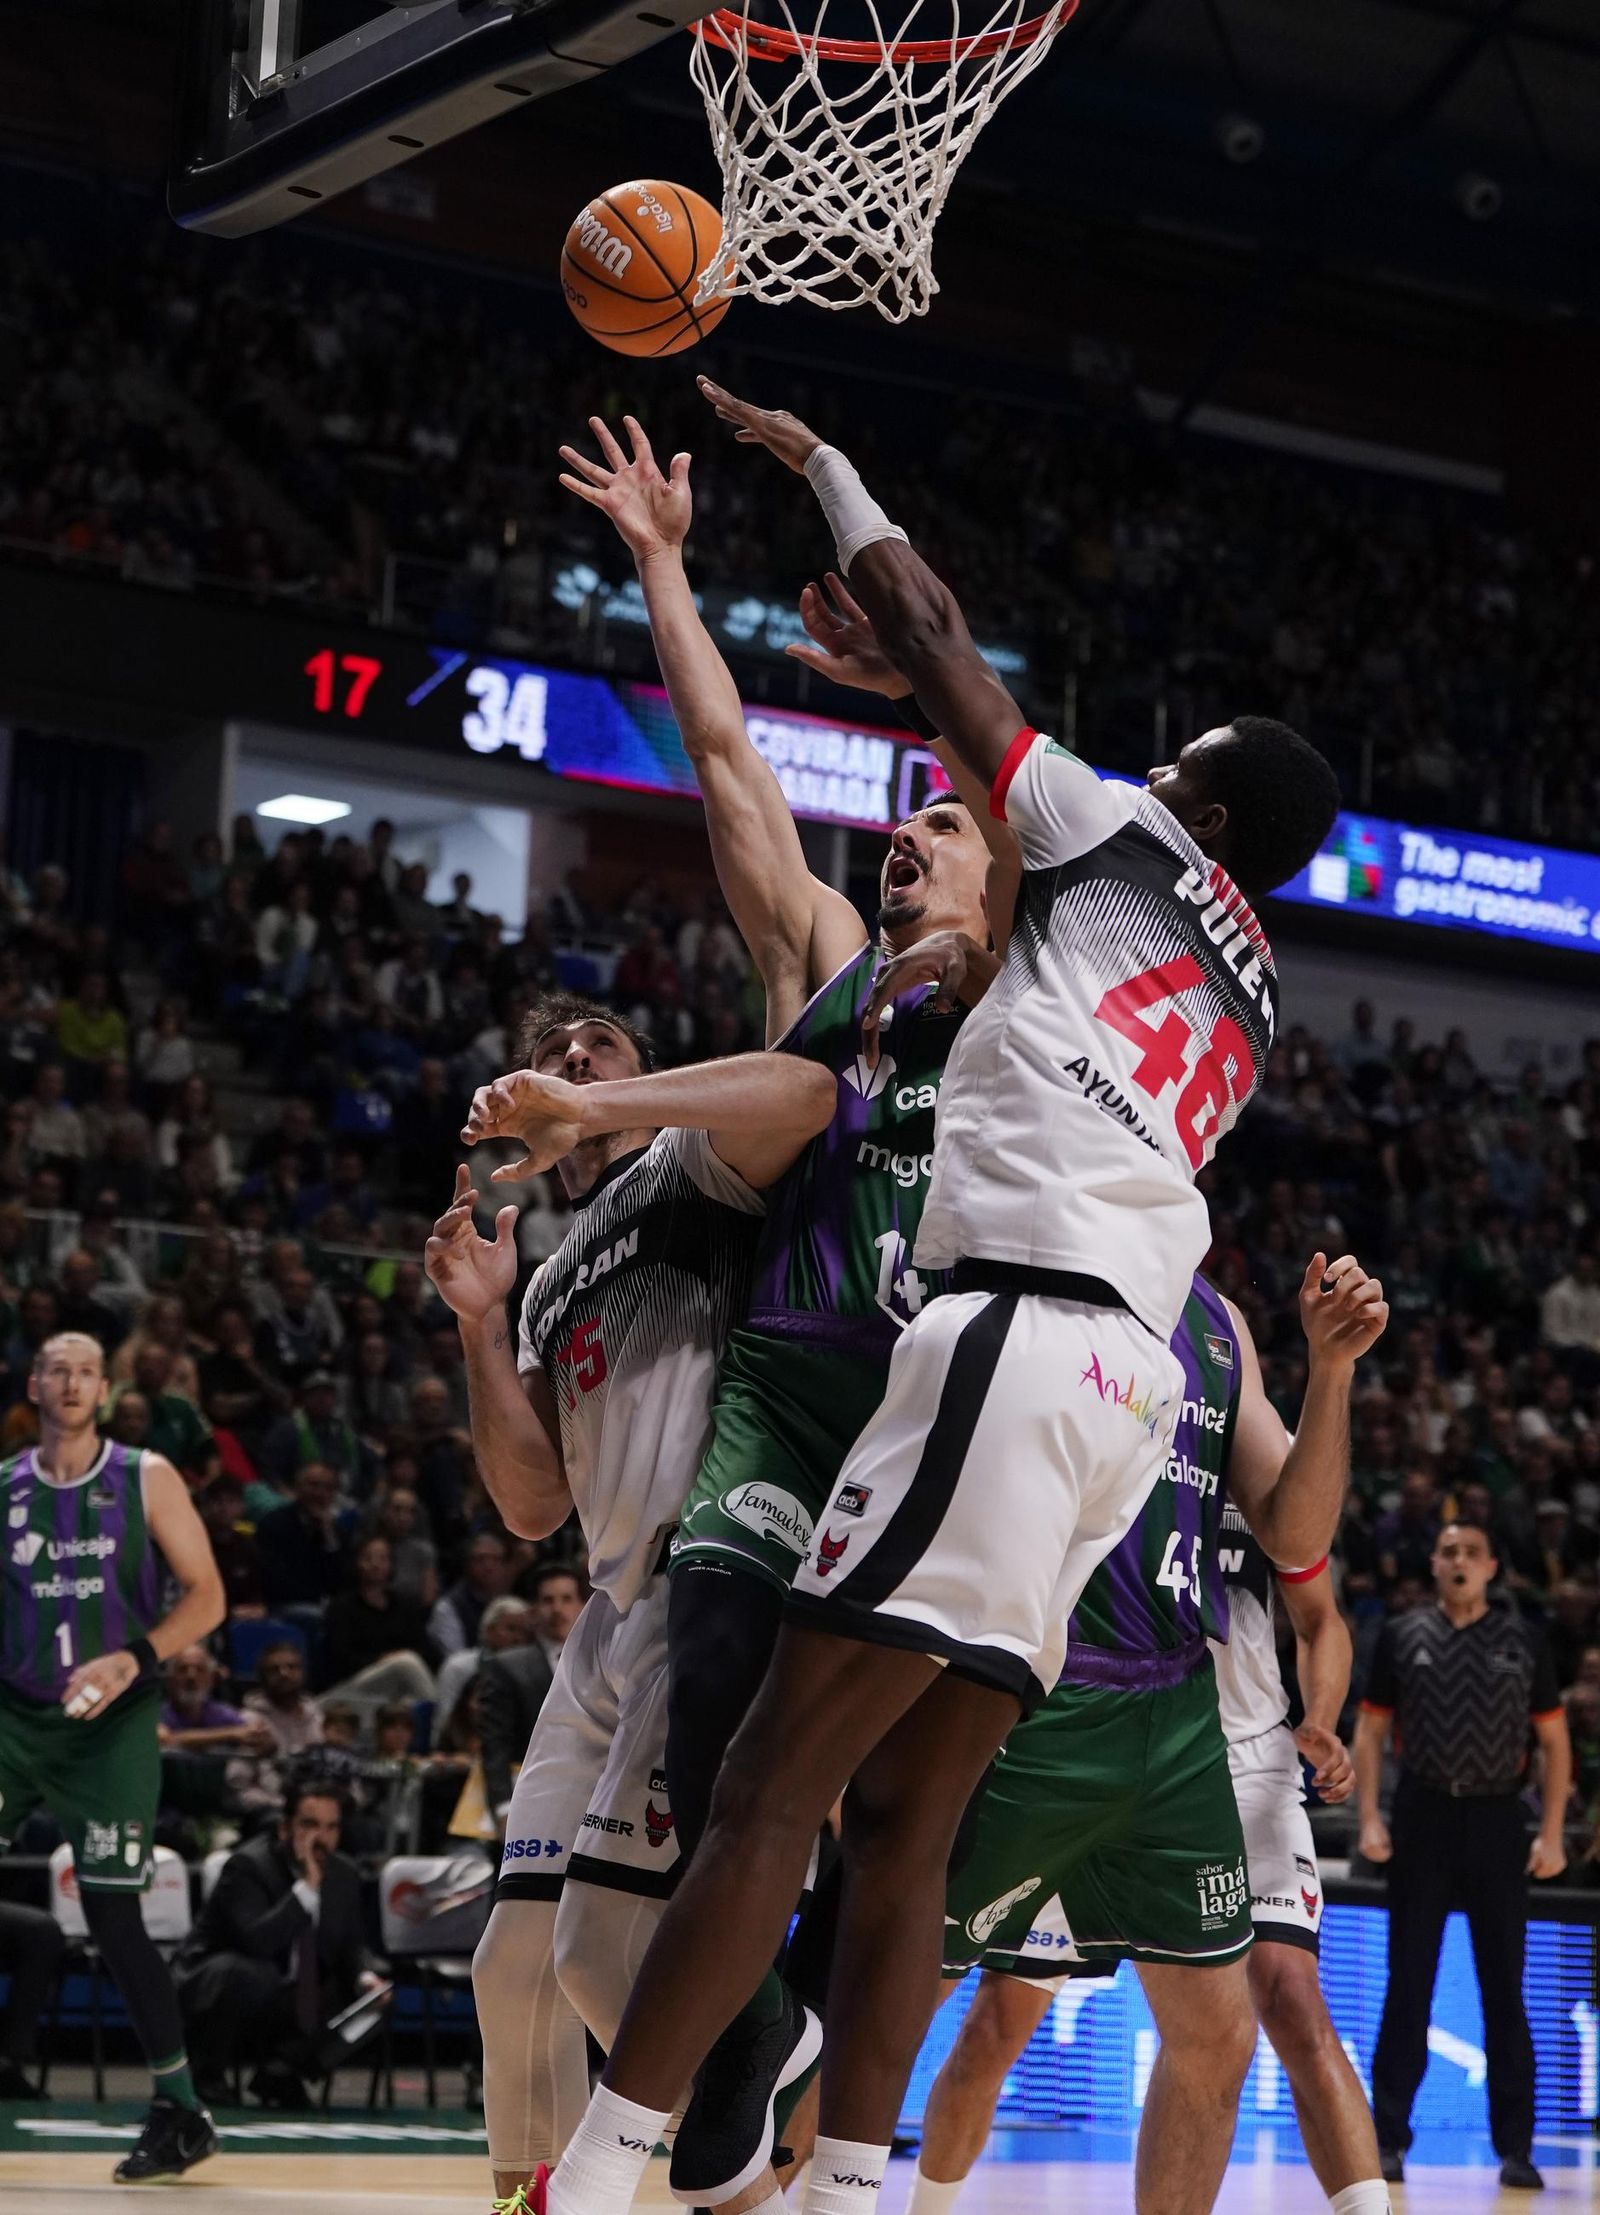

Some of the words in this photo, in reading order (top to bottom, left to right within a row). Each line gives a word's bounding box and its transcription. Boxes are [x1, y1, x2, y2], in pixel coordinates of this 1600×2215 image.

[574, 206, 633, 281] Wilso
[304, 648, 382, 719] 17
[461, 665, 549, 762] 34
[1181, 1396, 1228, 1434] nica
[838, 1495, 858, 1509] acb
[55, 1621, 73, 1667] 1
[651, 1779, 669, 1791] ac
[1196, 1863, 1225, 1876] sabor
[1198, 1886, 1248, 1918] laga
[617, 2134, 654, 2153] viv
